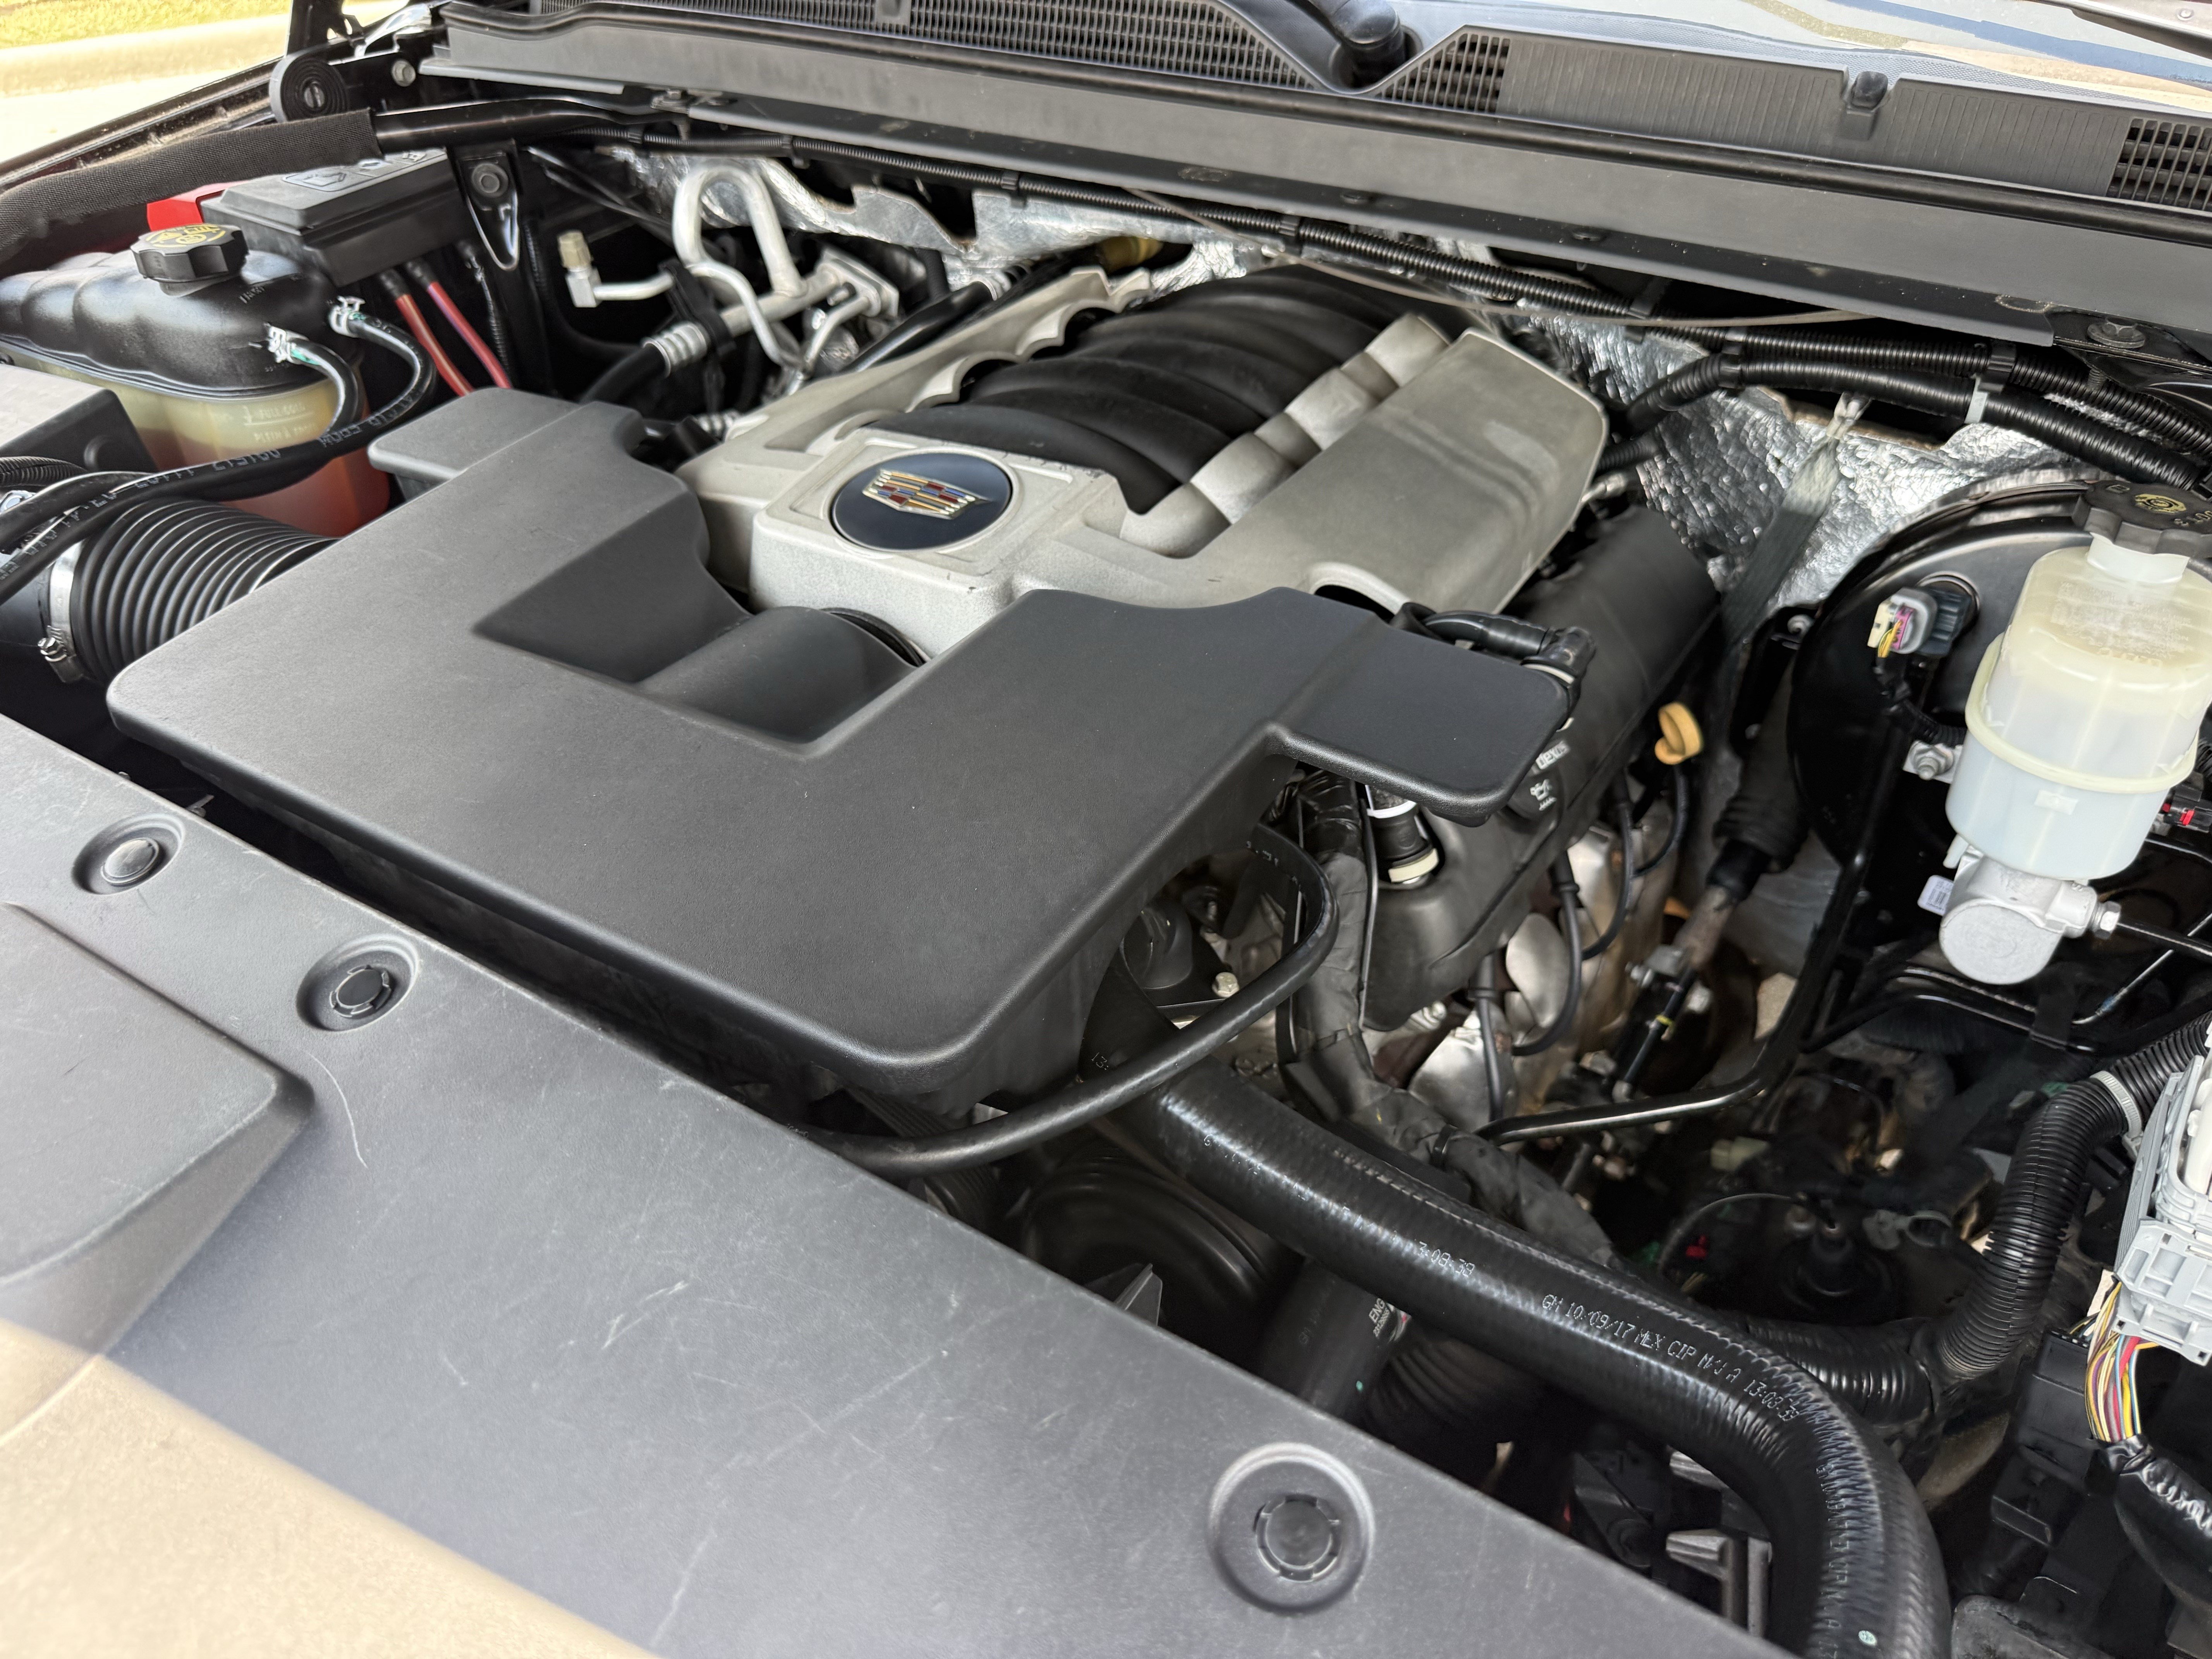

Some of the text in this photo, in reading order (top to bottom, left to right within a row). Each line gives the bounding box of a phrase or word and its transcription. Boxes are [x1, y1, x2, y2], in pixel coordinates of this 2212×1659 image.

[1369, 1298, 1385, 1323] ENG
[1542, 1294, 1563, 1312] GM
[1634, 1328, 1665, 1351] MEX
[1667, 1340, 1697, 1360] CIP
